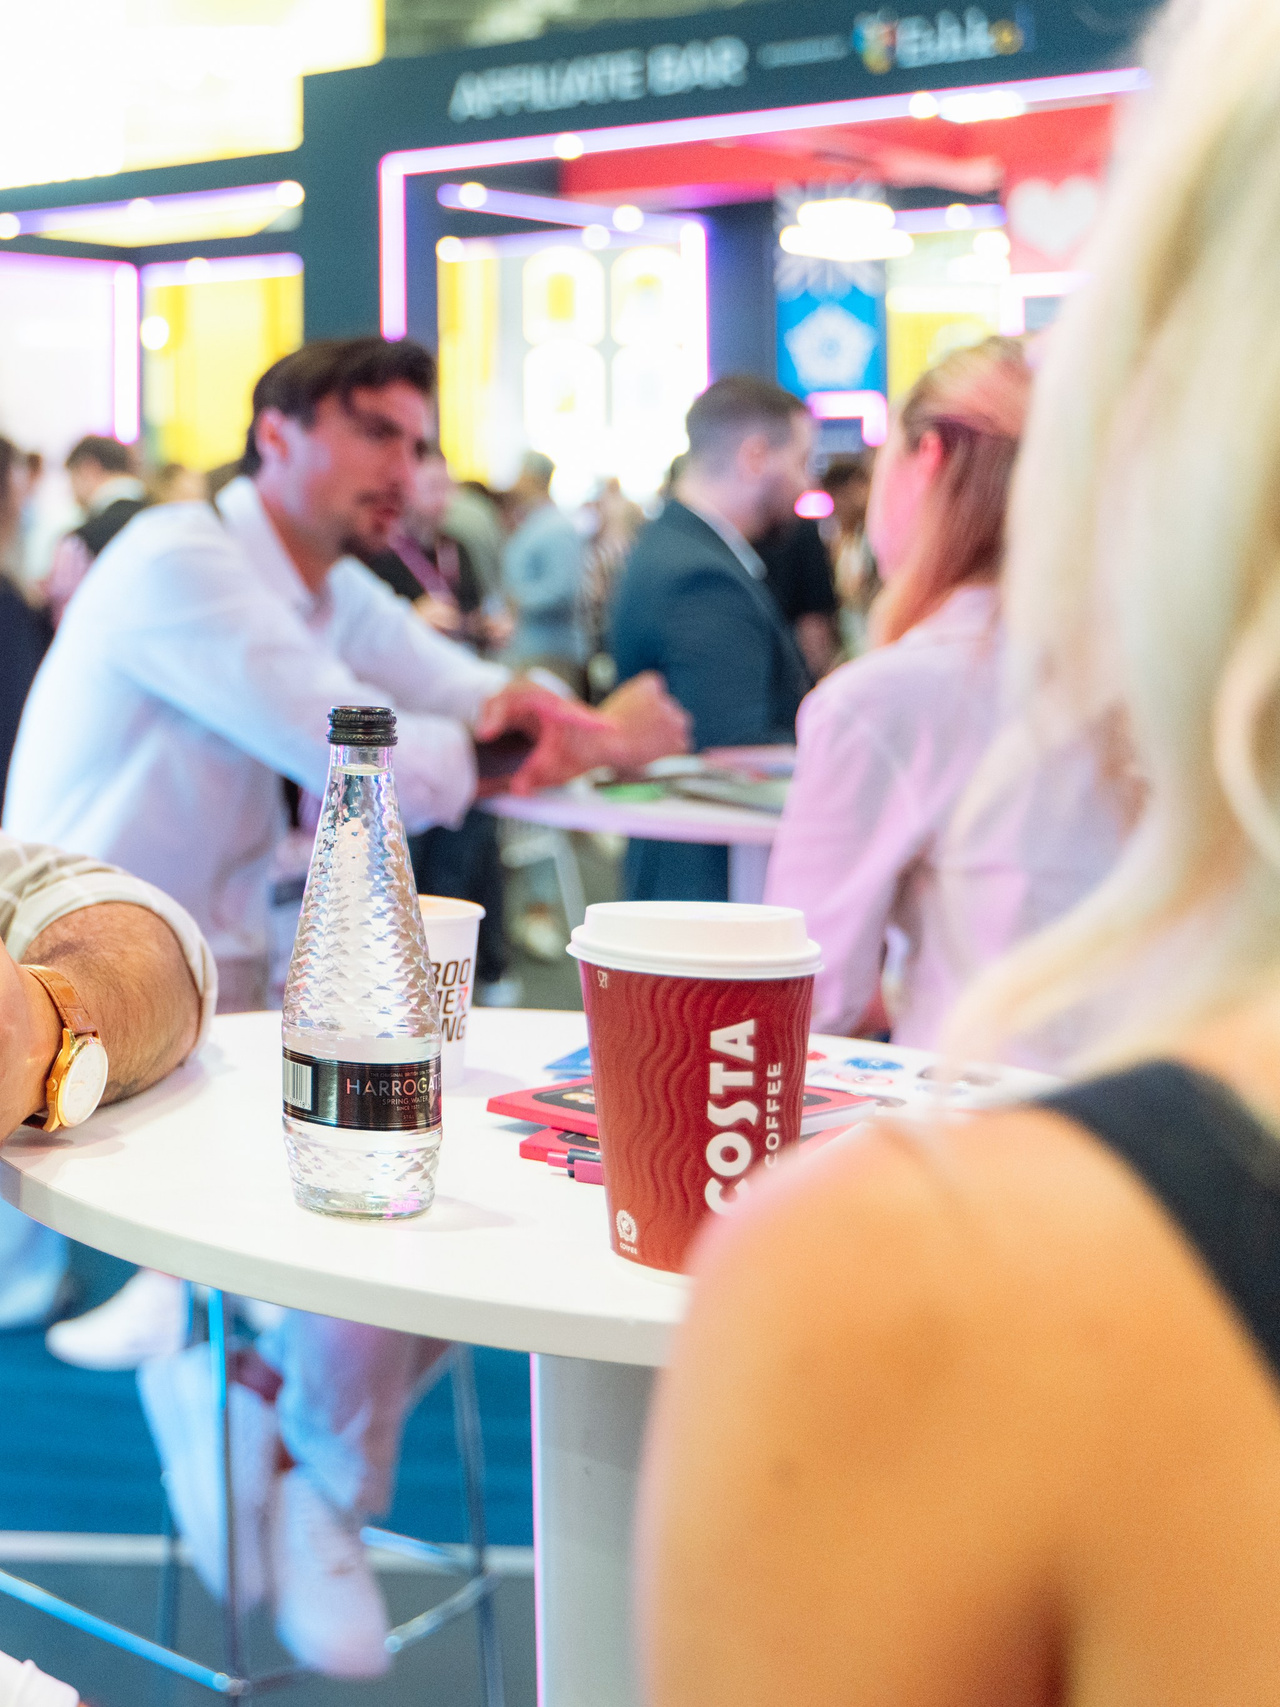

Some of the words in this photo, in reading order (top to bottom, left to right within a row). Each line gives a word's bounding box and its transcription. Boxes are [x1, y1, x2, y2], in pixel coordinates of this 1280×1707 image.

[382, 1098, 409, 1106] SPRING
[705, 1019, 759, 1216] COSTA
[765, 1062, 782, 1169] COFFEE
